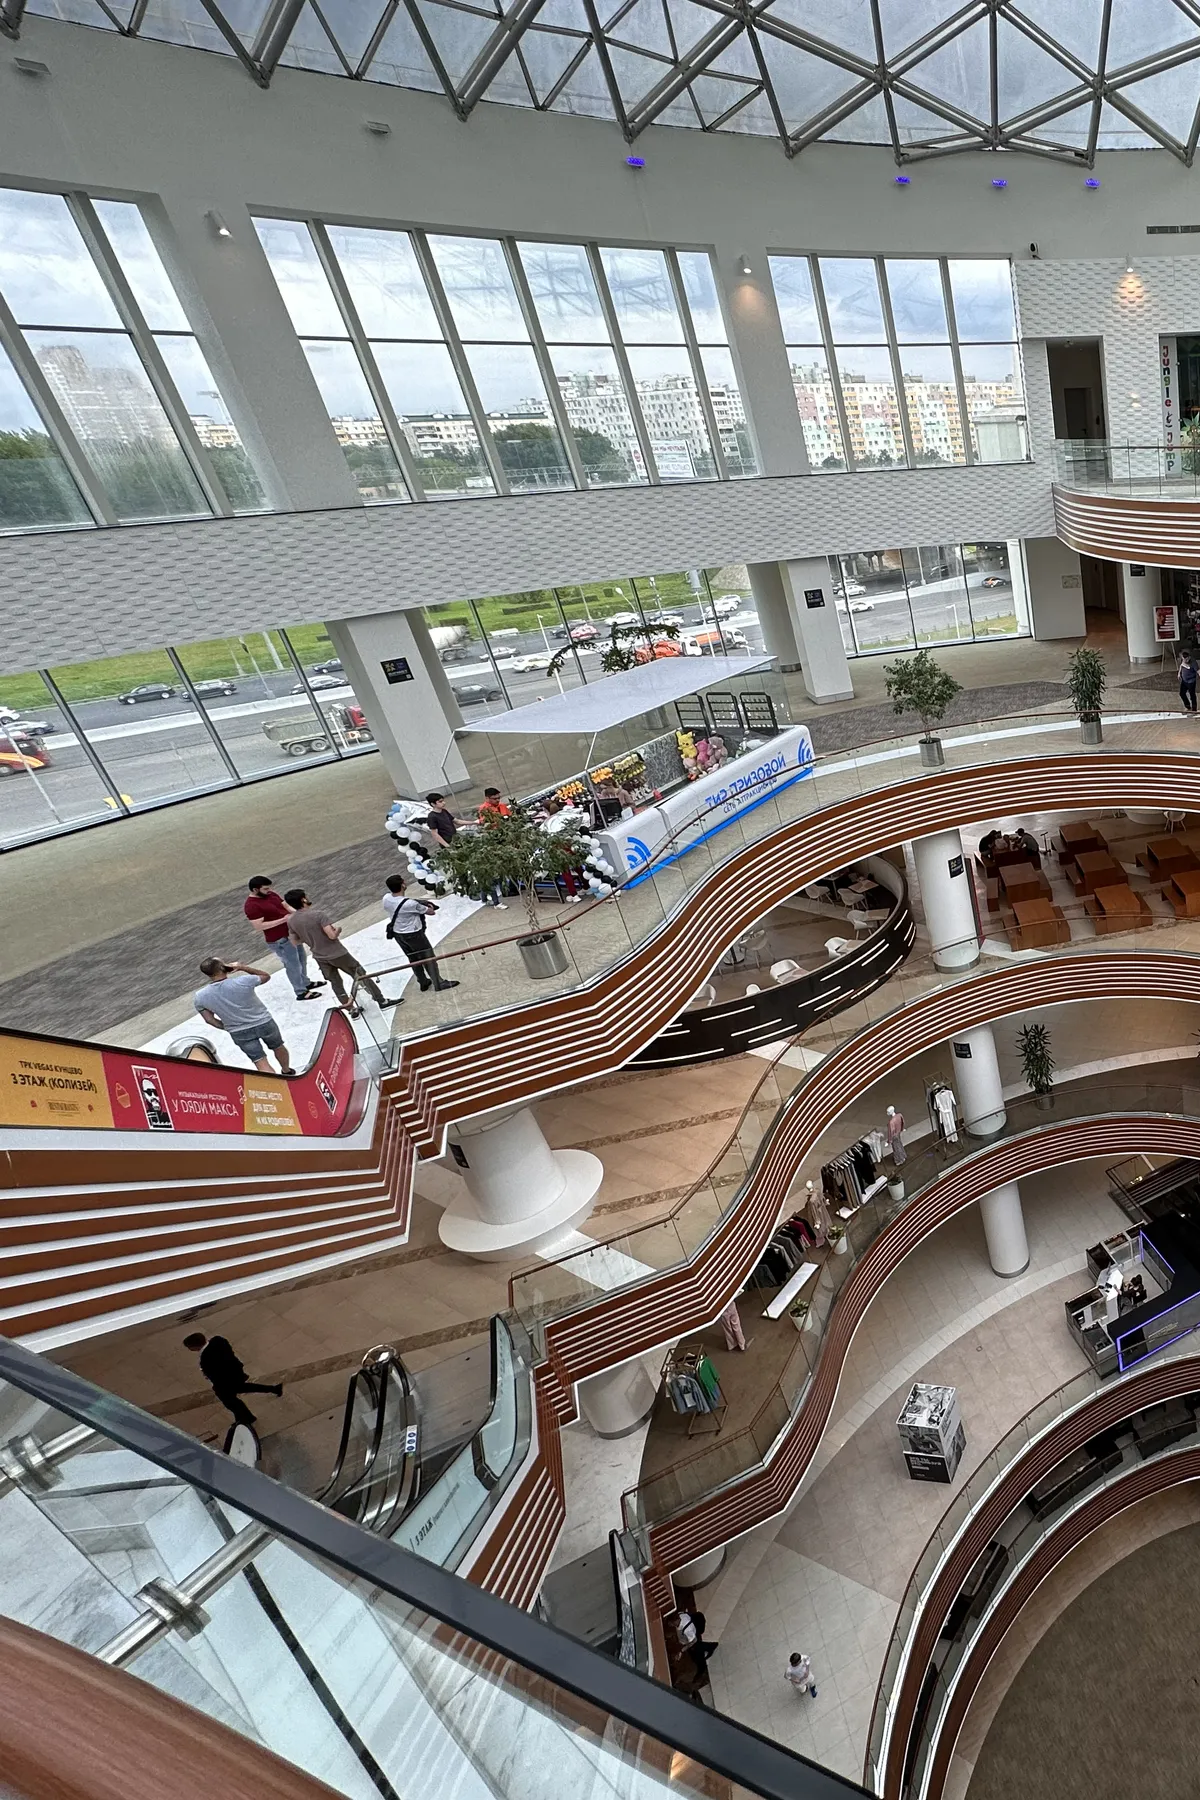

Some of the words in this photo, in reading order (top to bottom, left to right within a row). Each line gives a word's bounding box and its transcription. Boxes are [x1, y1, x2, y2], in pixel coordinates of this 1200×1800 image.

[1162, 345, 1172, 408] Jungle
[33, 1062, 53, 1072] VEGAS
[11, 1073, 18, 1084] 3
[19, 1074, 48, 1088] ЭТАЖ
[48, 1077, 98, 1094] (КОЛИЗЕЙ)
[208, 1102, 239, 1116] МАКСА
